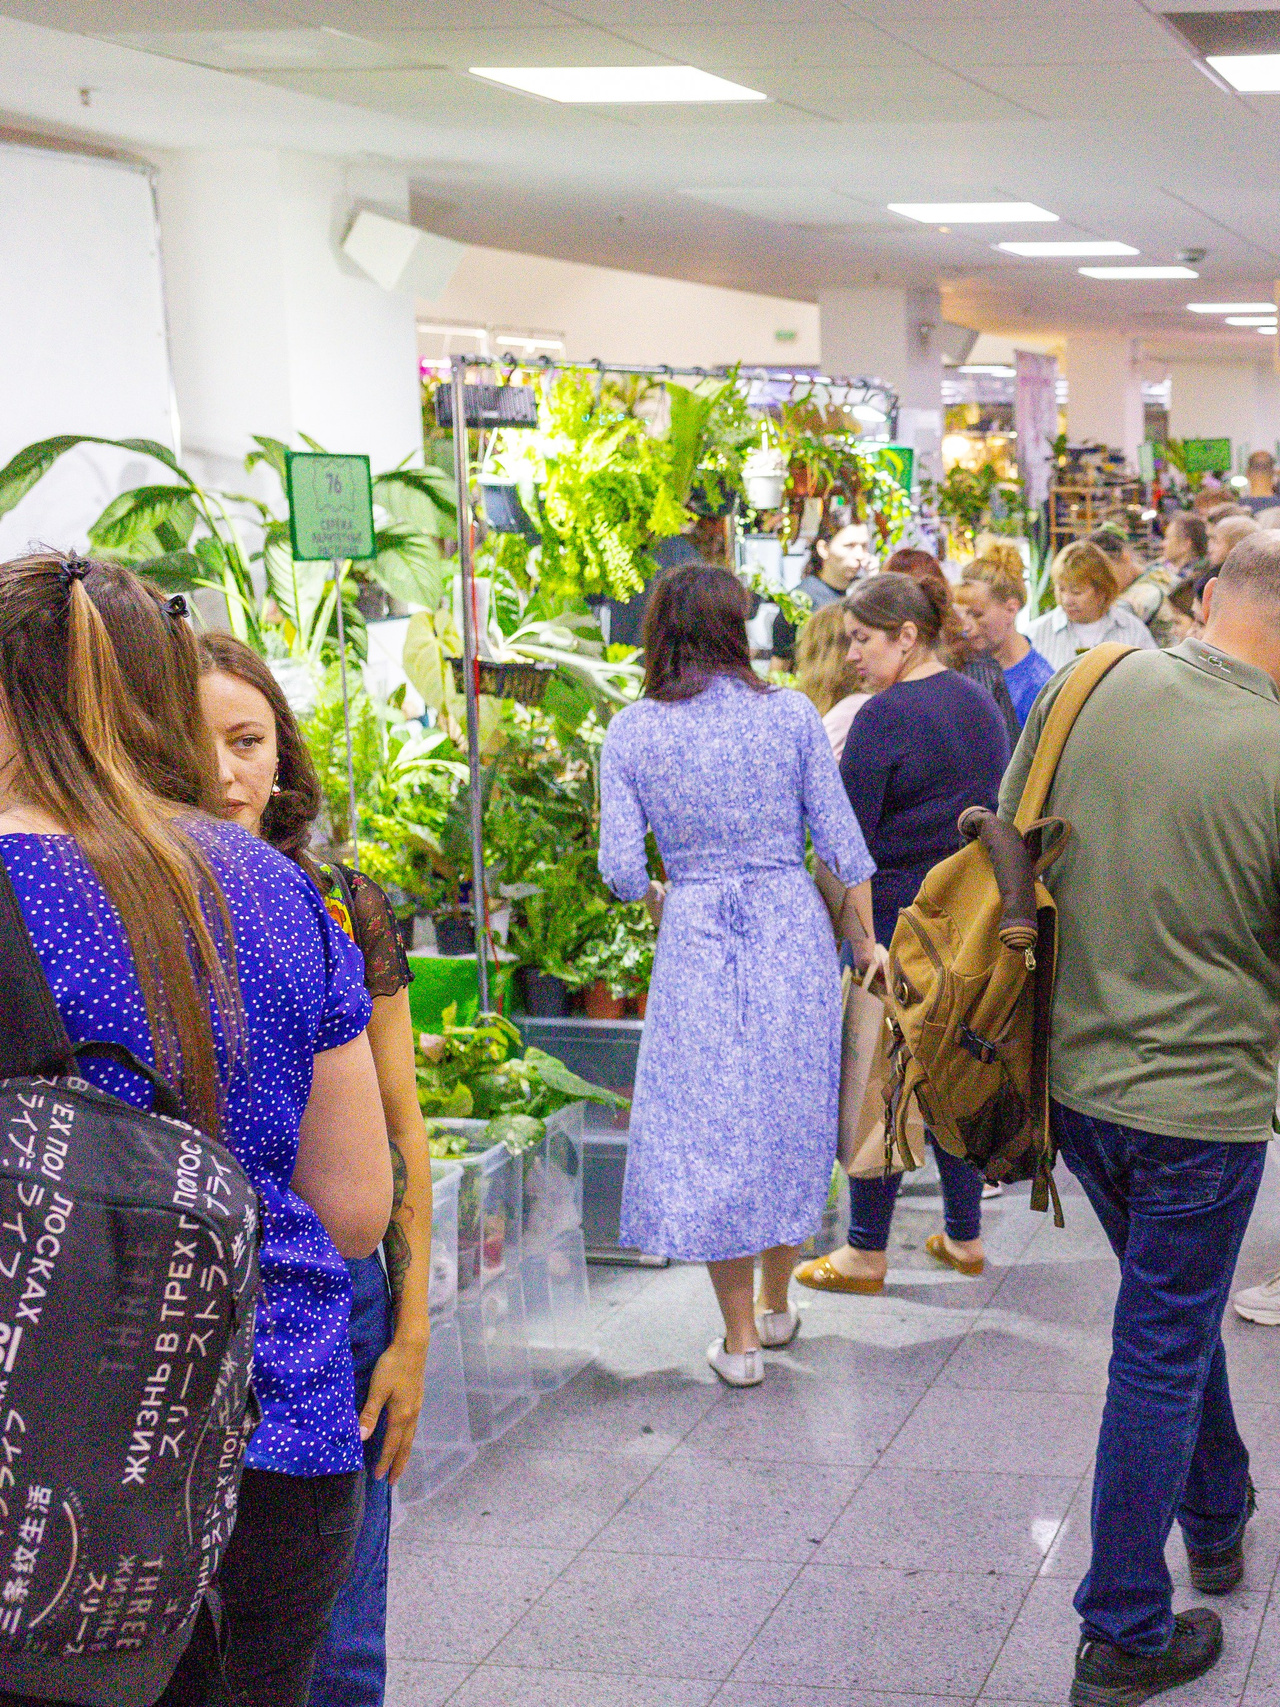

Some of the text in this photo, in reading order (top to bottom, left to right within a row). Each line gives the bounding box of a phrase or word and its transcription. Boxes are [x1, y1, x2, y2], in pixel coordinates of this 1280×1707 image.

[326, 472, 342, 494] 76
[49, 1104, 75, 1136] ЕХ
[160, 1239, 198, 1321] ТРЕХ
[154, 1332, 181, 1353] В
[122, 1362, 173, 1485] ЖИЗНЬ
[115, 1553, 164, 1648] THREE
